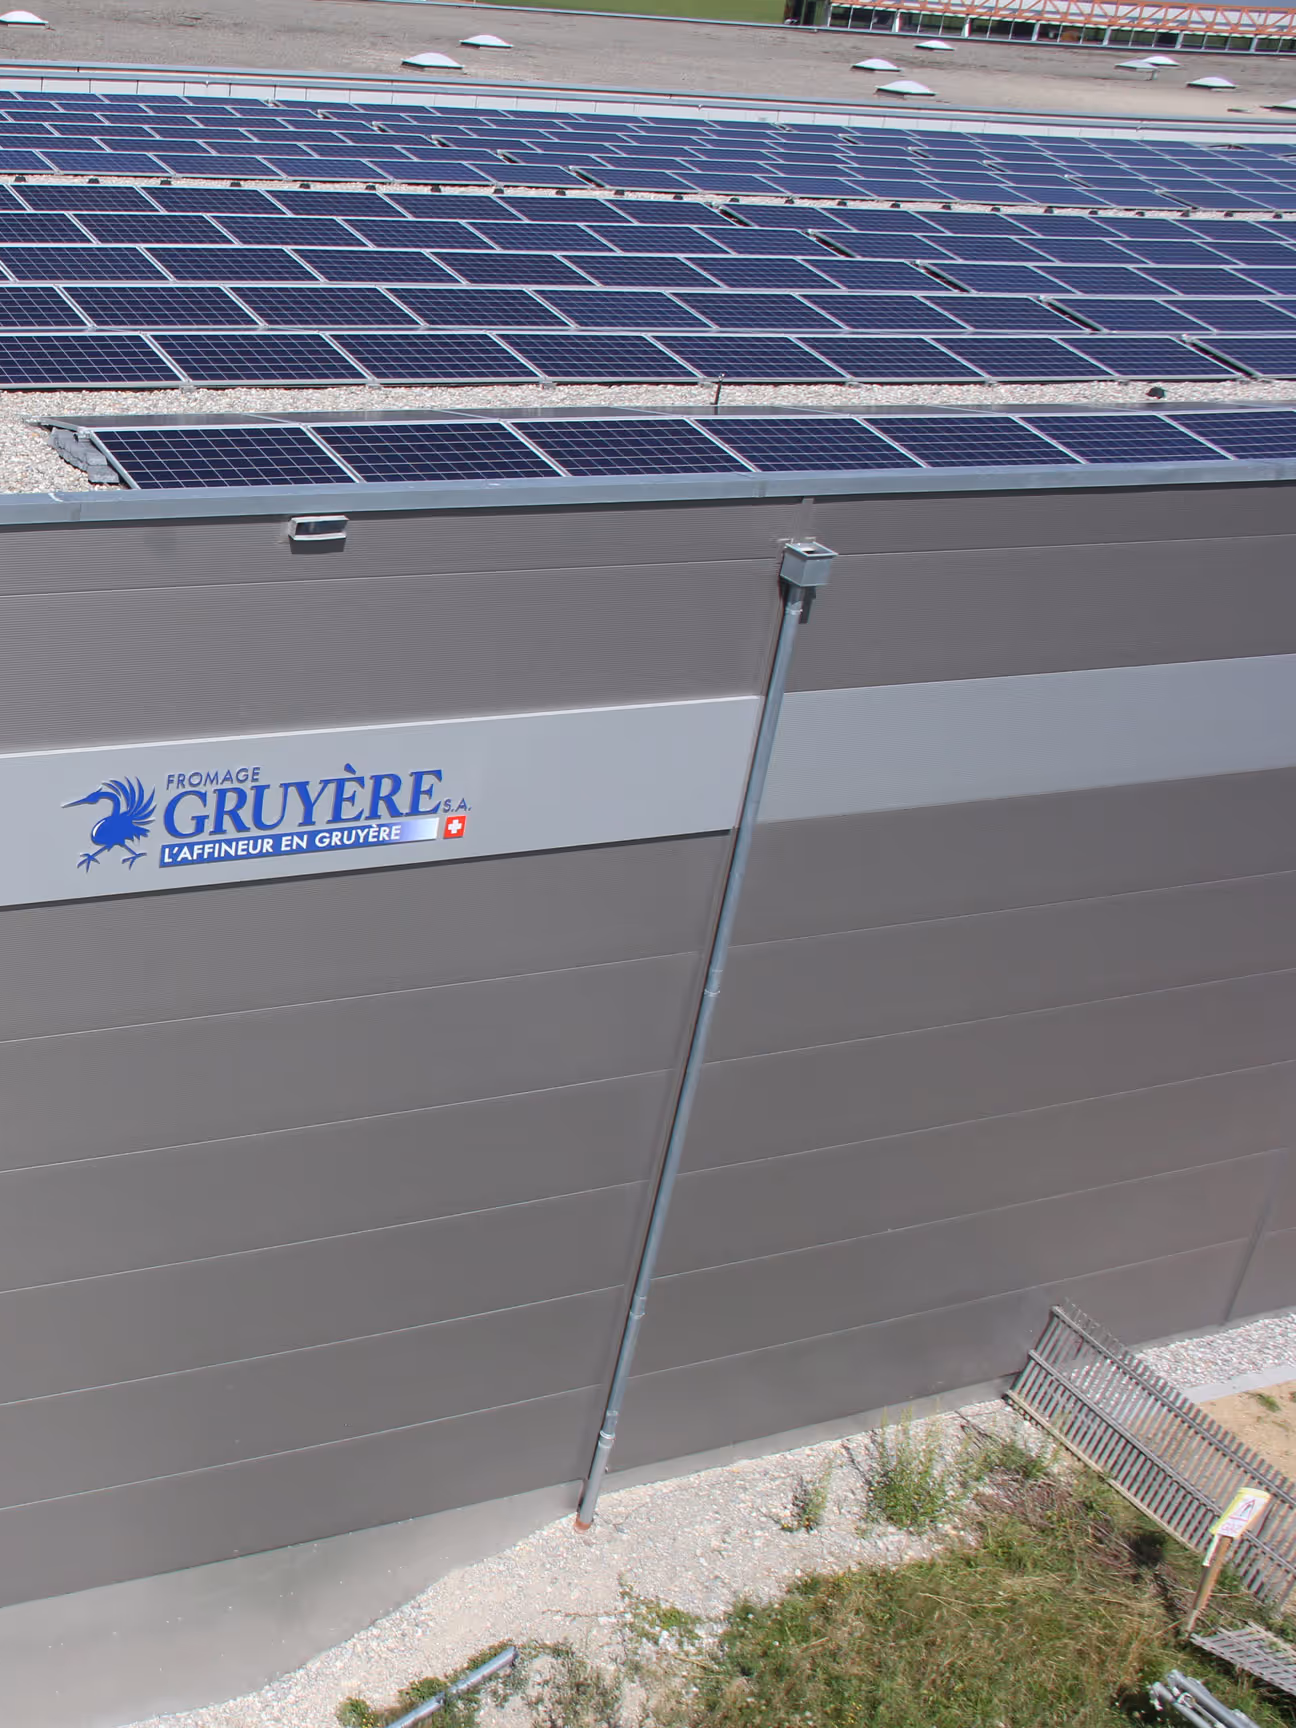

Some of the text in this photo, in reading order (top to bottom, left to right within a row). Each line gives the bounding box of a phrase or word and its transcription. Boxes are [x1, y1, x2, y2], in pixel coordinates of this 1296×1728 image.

[166, 766, 261, 790] FROMAGE
[163, 763, 472, 839] GRUYÈRE S.A.
[164, 825, 401, 862] L'AFFINEUR EN GRUYÈRE
